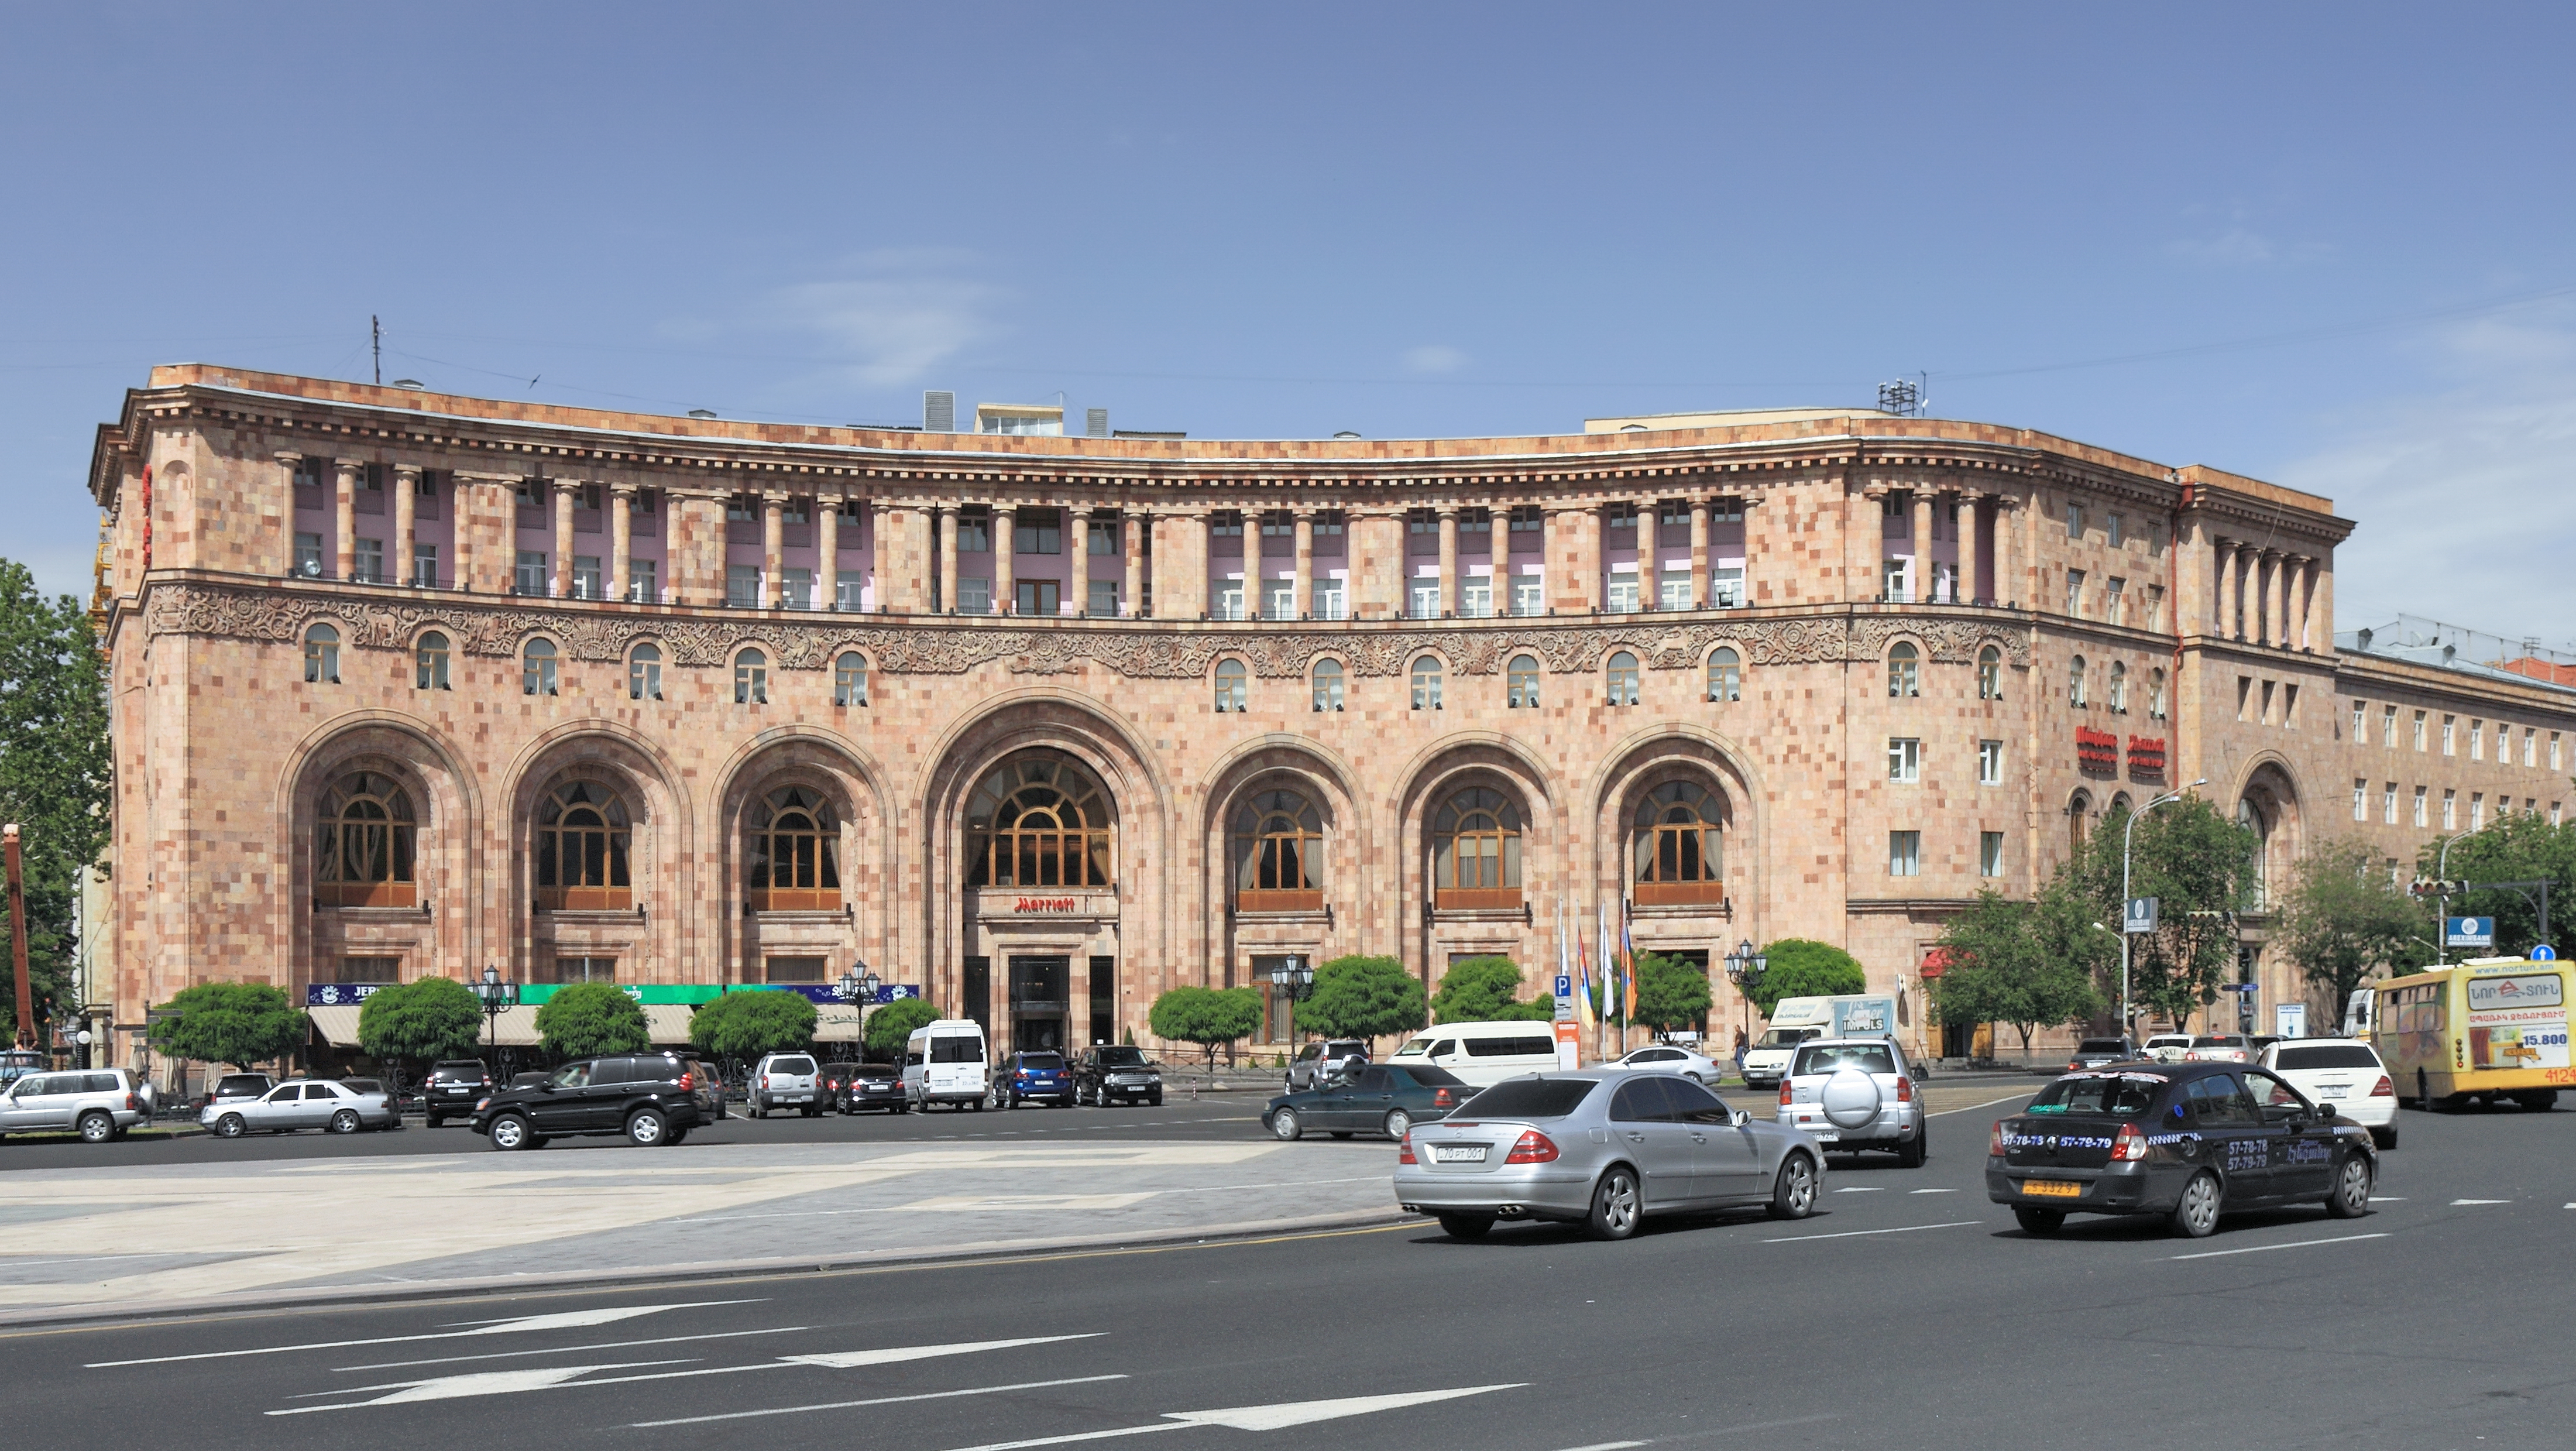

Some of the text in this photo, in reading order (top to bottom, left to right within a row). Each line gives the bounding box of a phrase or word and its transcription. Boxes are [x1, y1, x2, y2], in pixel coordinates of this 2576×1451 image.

[1014, 897, 1075, 913] Marriott
[2475, 964, 2554, 974] www.nortun.am
[1558, 977, 1568, 995] P
[2524, 1034, 2567, 1045] 15.800
[1444, 1148, 1454, 1158] 70
[1467, 1148, 1482, 1158] 001
[2042, 1182, 2073, 1193] 3329
